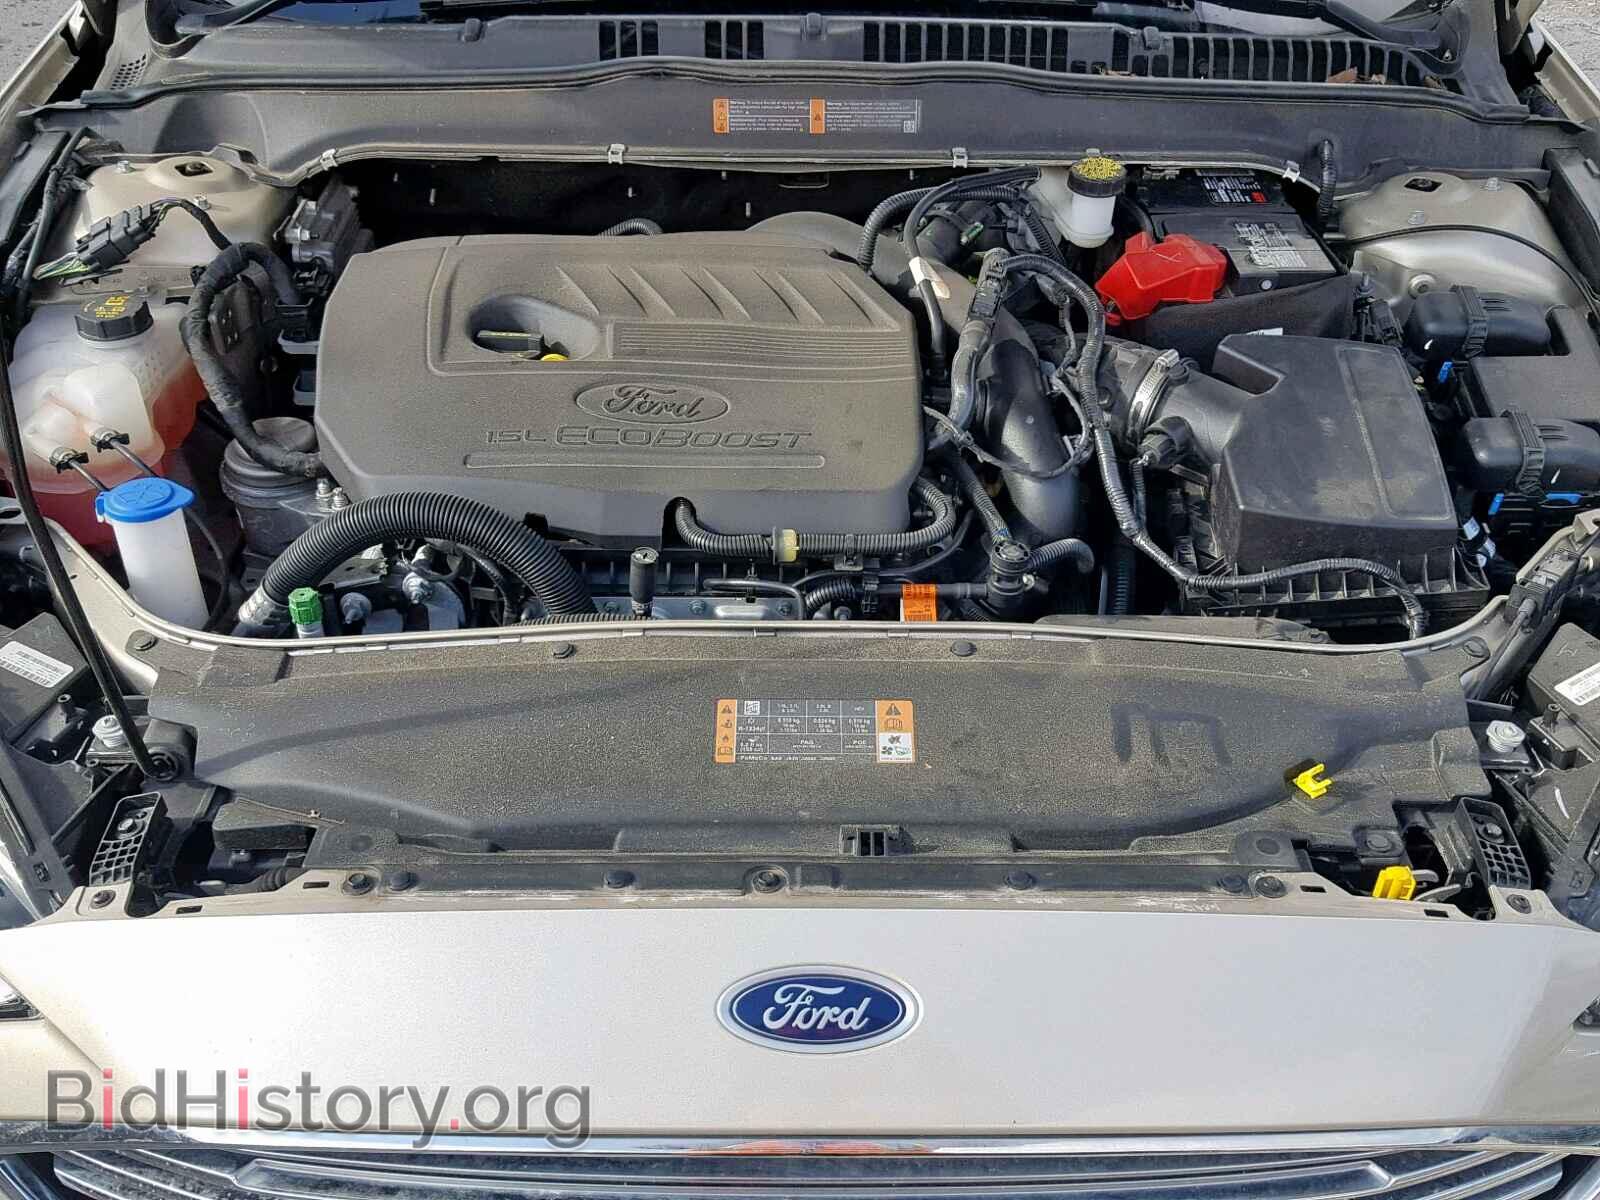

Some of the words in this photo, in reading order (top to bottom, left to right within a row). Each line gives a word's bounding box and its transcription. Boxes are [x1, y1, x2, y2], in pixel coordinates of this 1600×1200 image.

[602, 384, 704, 418] Ford
[554, 425, 812, 449] ECOBOOST
[763, 983, 872, 1030] Ford
